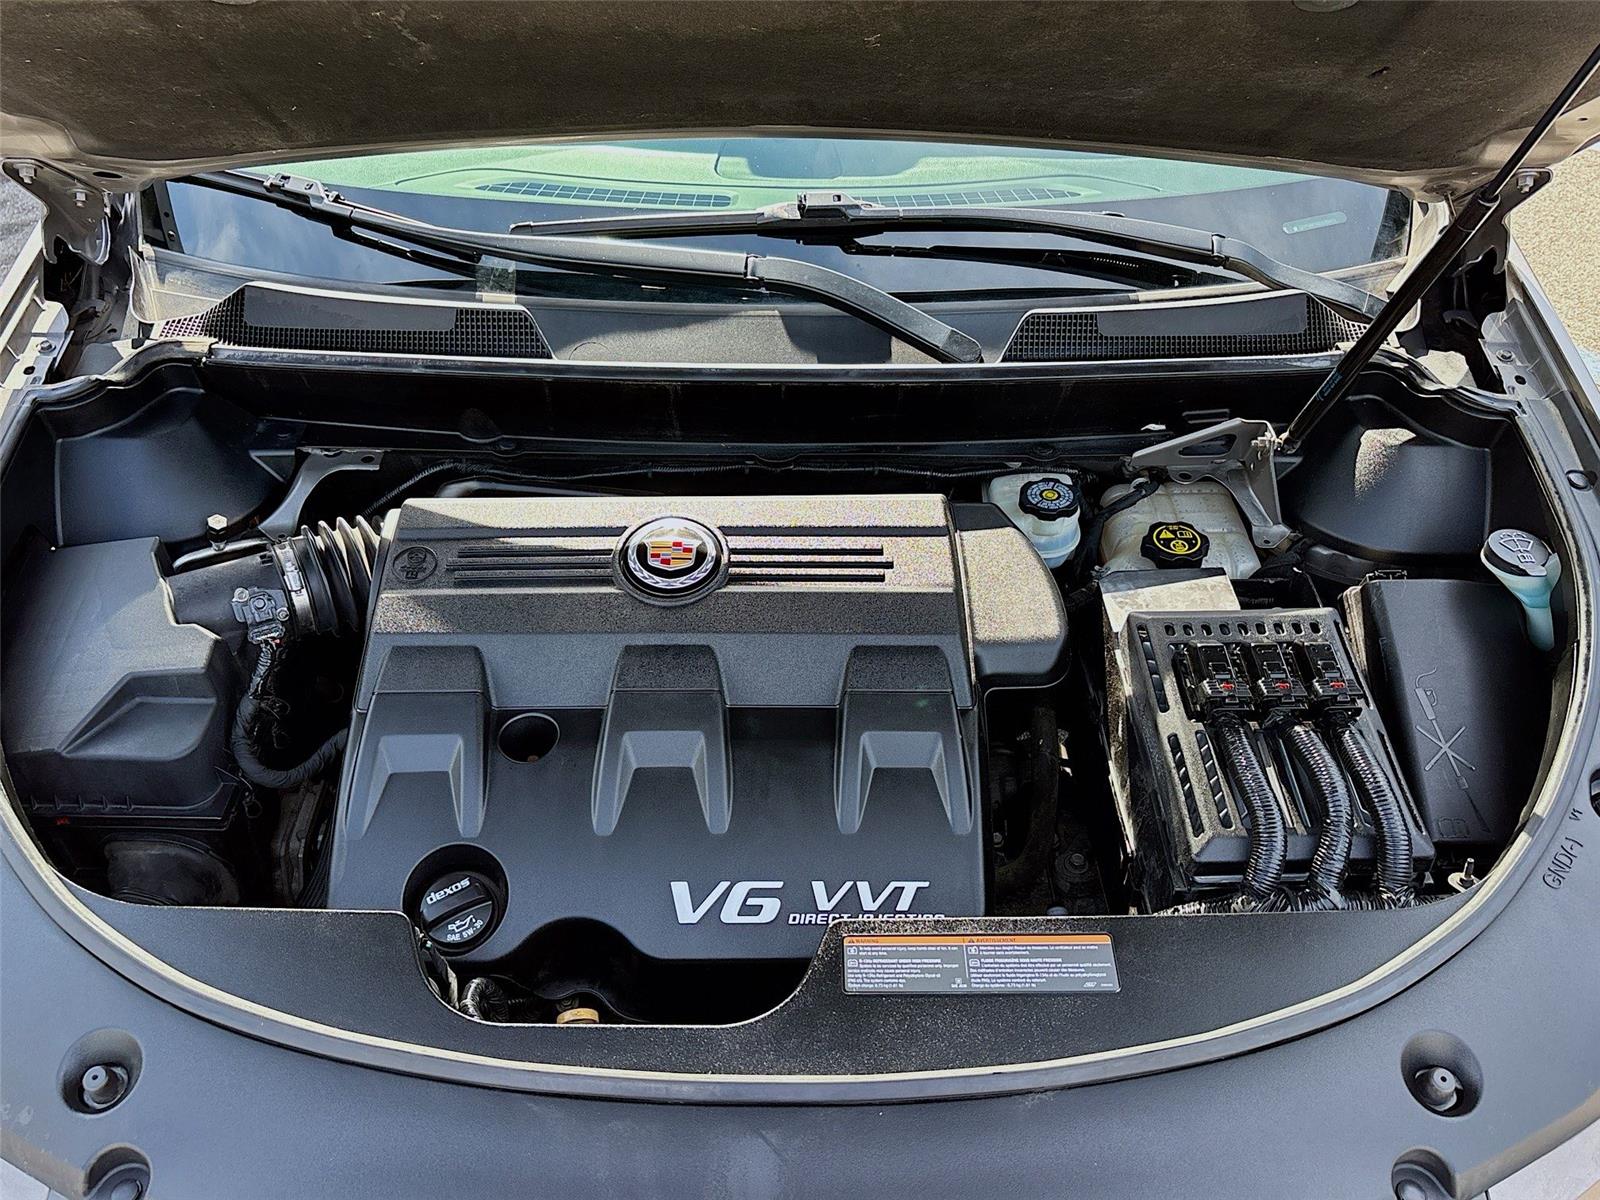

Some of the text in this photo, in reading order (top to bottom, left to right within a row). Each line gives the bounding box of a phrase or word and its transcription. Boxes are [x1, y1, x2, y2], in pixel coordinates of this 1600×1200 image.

[426, 877, 471, 905] dexos
[670, 880, 930, 924] V6 VVT
[446, 919, 484, 941] SAE 5W-30
